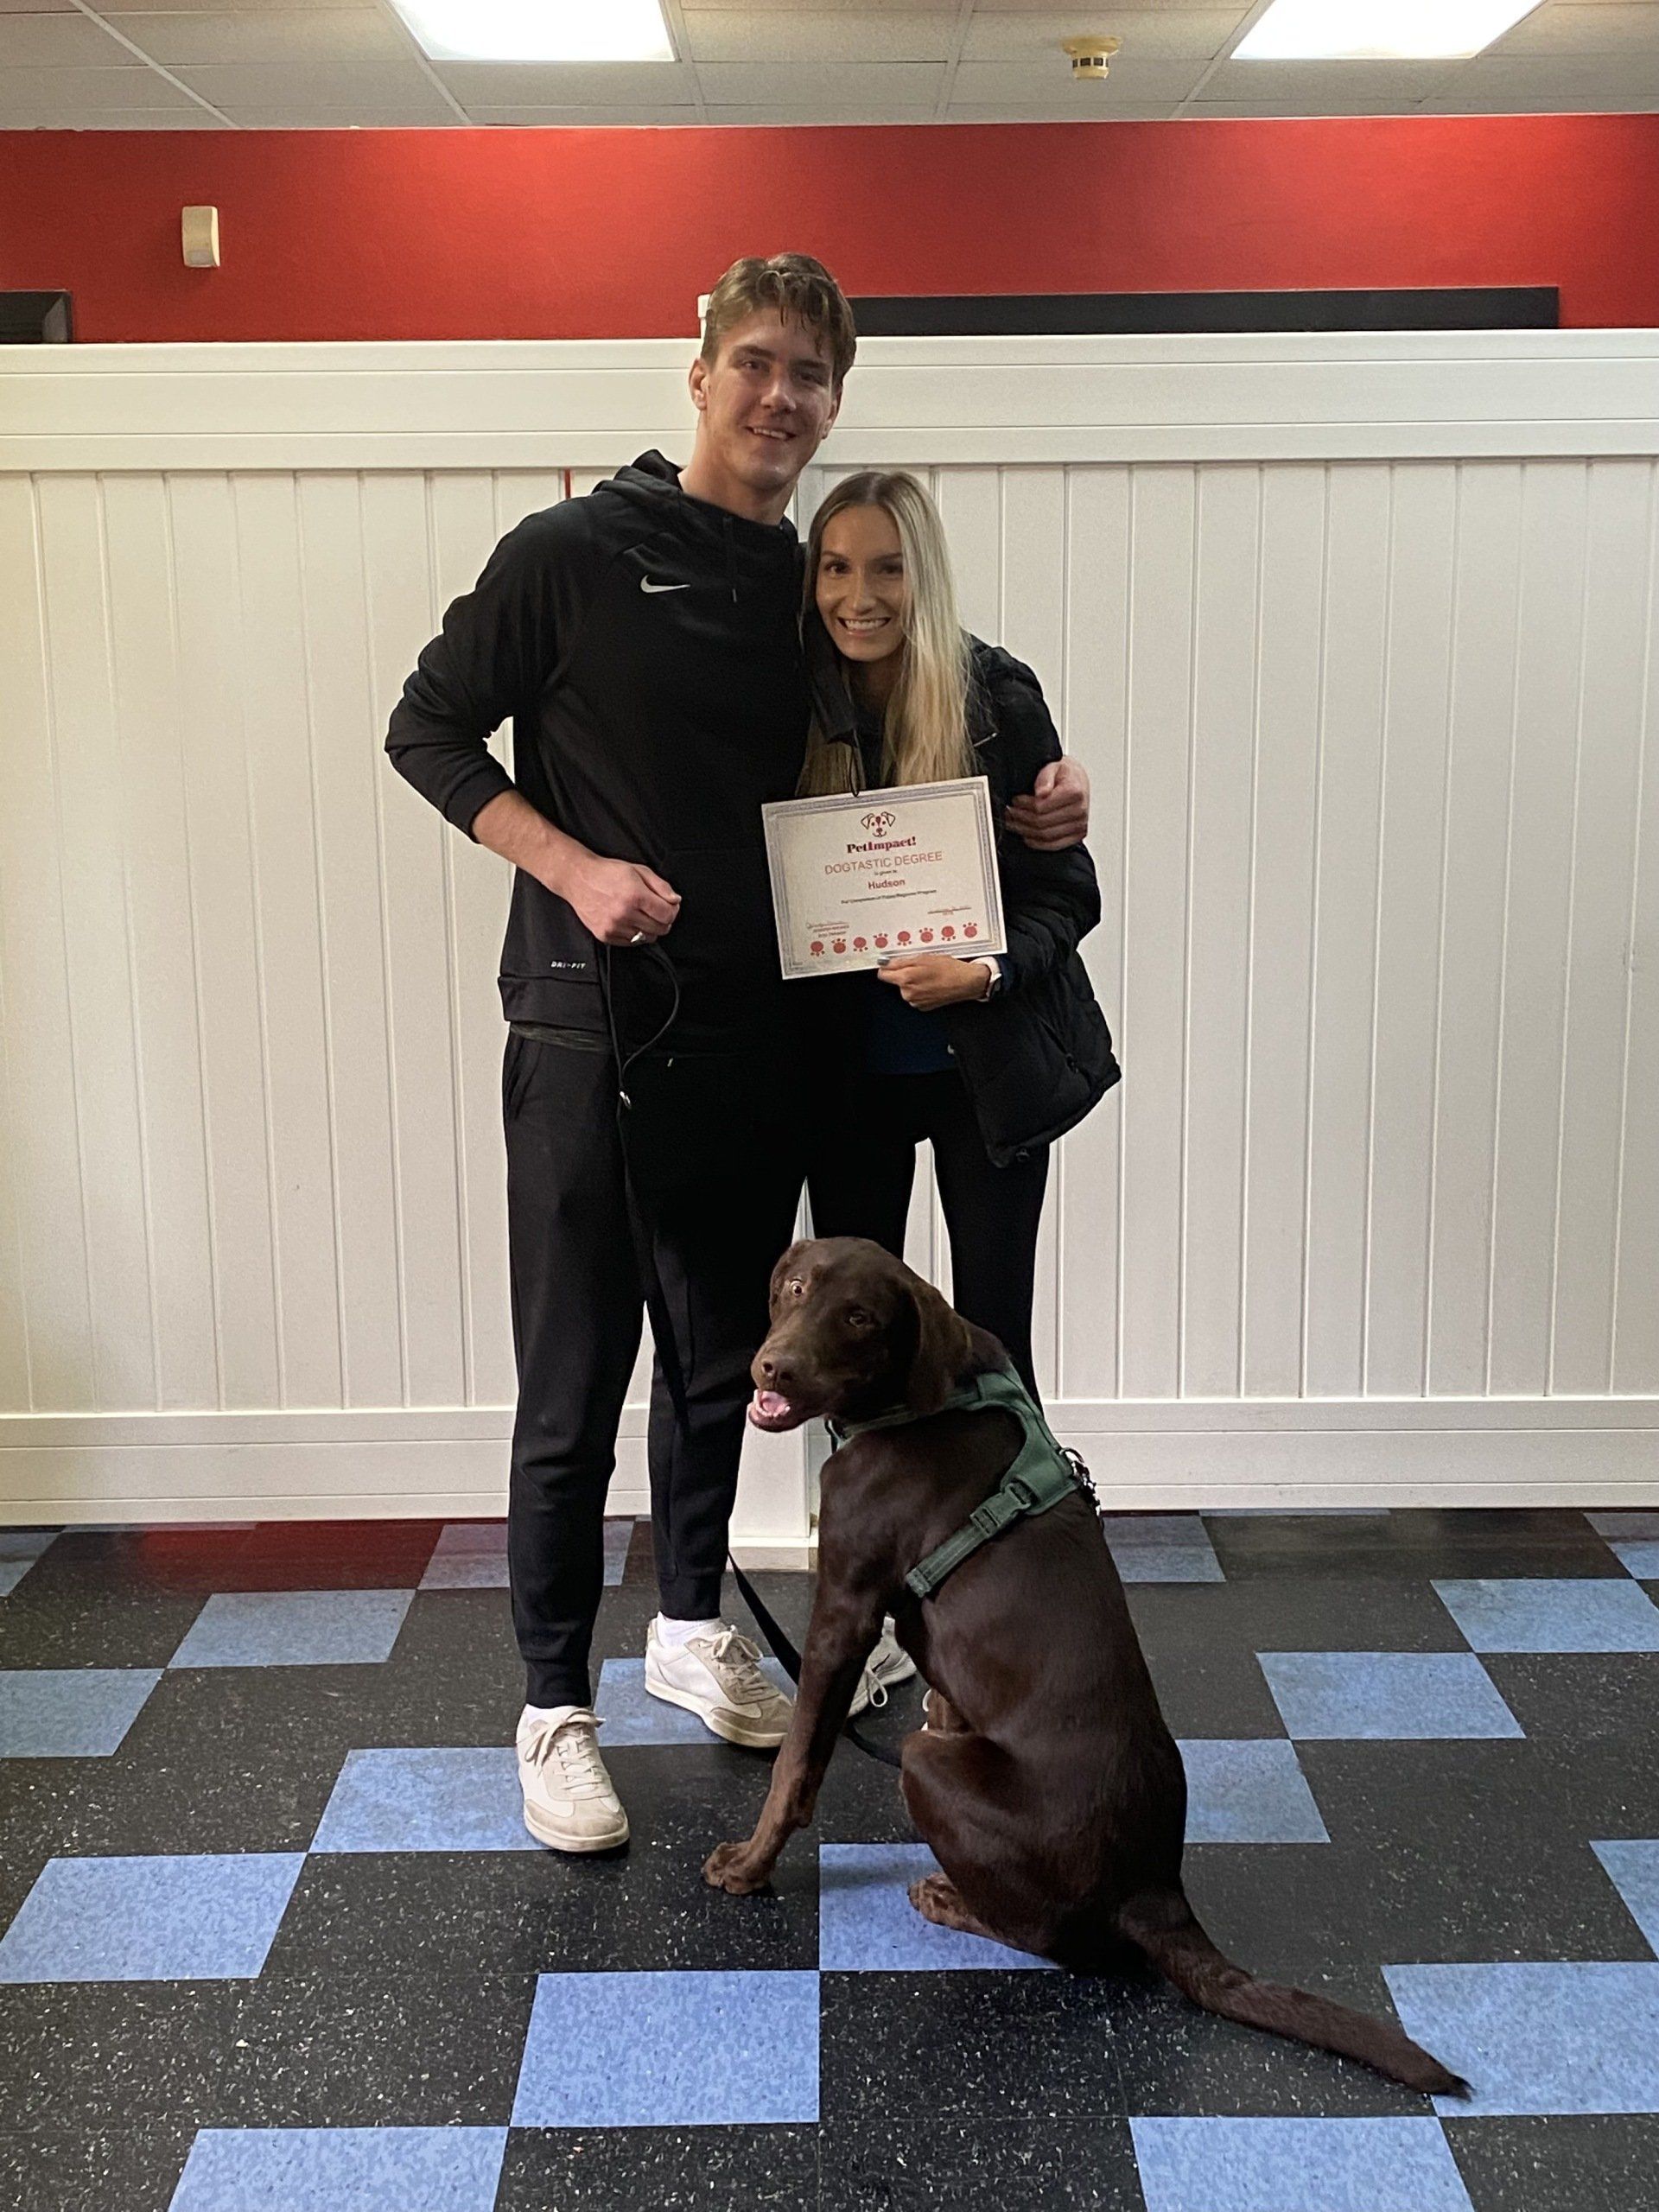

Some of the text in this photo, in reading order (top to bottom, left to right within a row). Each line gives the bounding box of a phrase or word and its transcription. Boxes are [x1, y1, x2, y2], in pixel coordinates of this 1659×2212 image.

[847, 836, 916, 854] PetImpact!
[824, 851, 943, 875] DOGTASTIC DEGREE
[868, 880, 906, 890] Hudson
